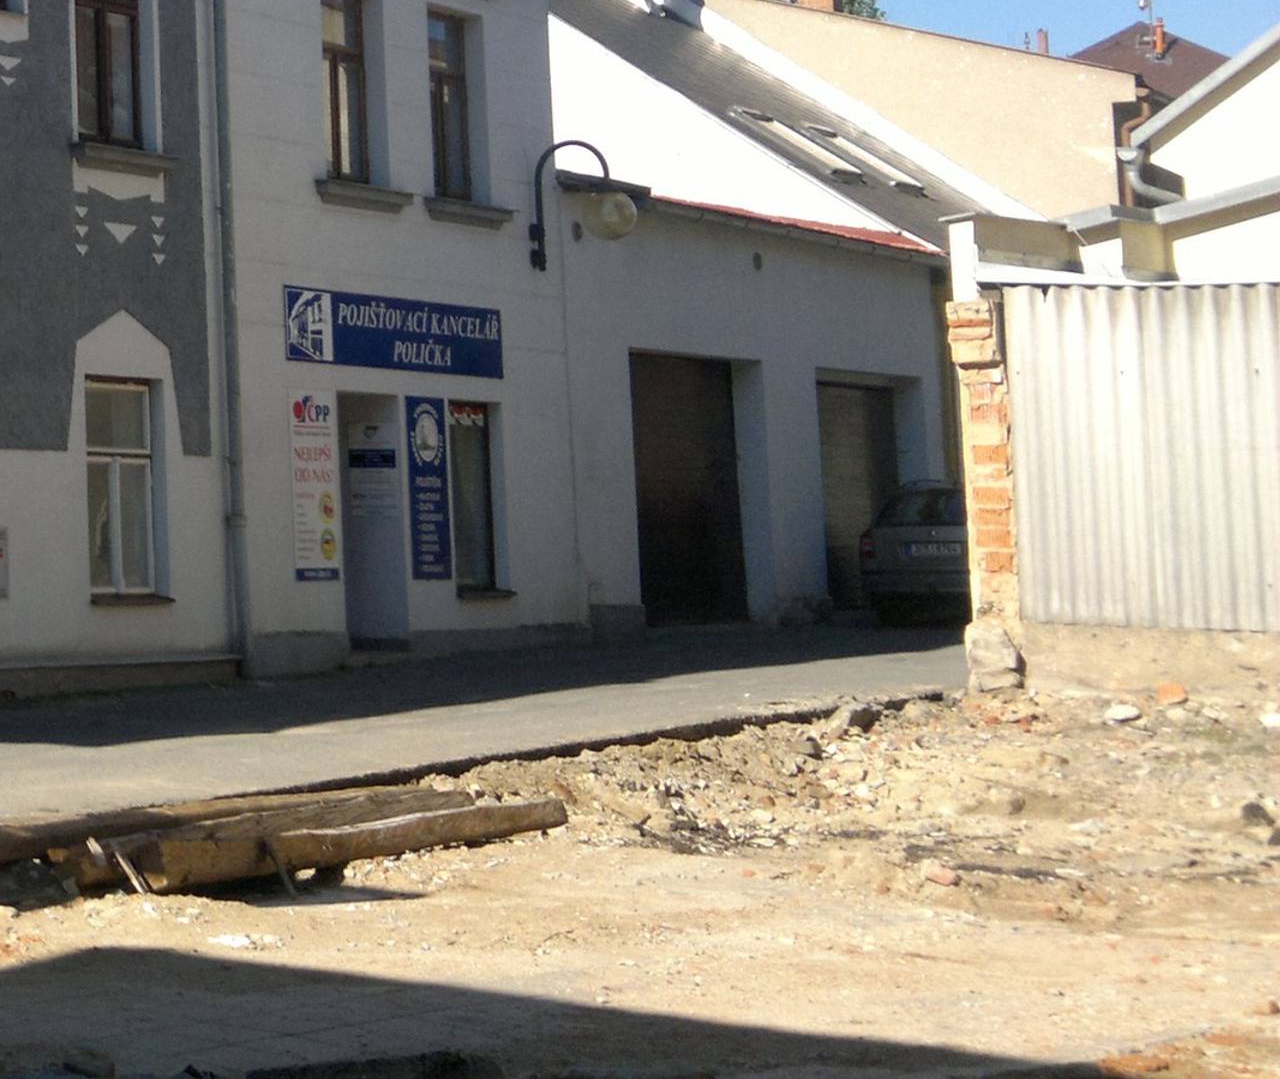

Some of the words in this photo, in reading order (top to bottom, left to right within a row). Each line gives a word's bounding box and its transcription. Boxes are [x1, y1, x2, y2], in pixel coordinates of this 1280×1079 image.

[337, 300, 429, 333] POJIŠŤOVACÍ
[431, 313, 500, 340] KANCELÁŘ
[393, 339, 452, 367] POLIČKA
